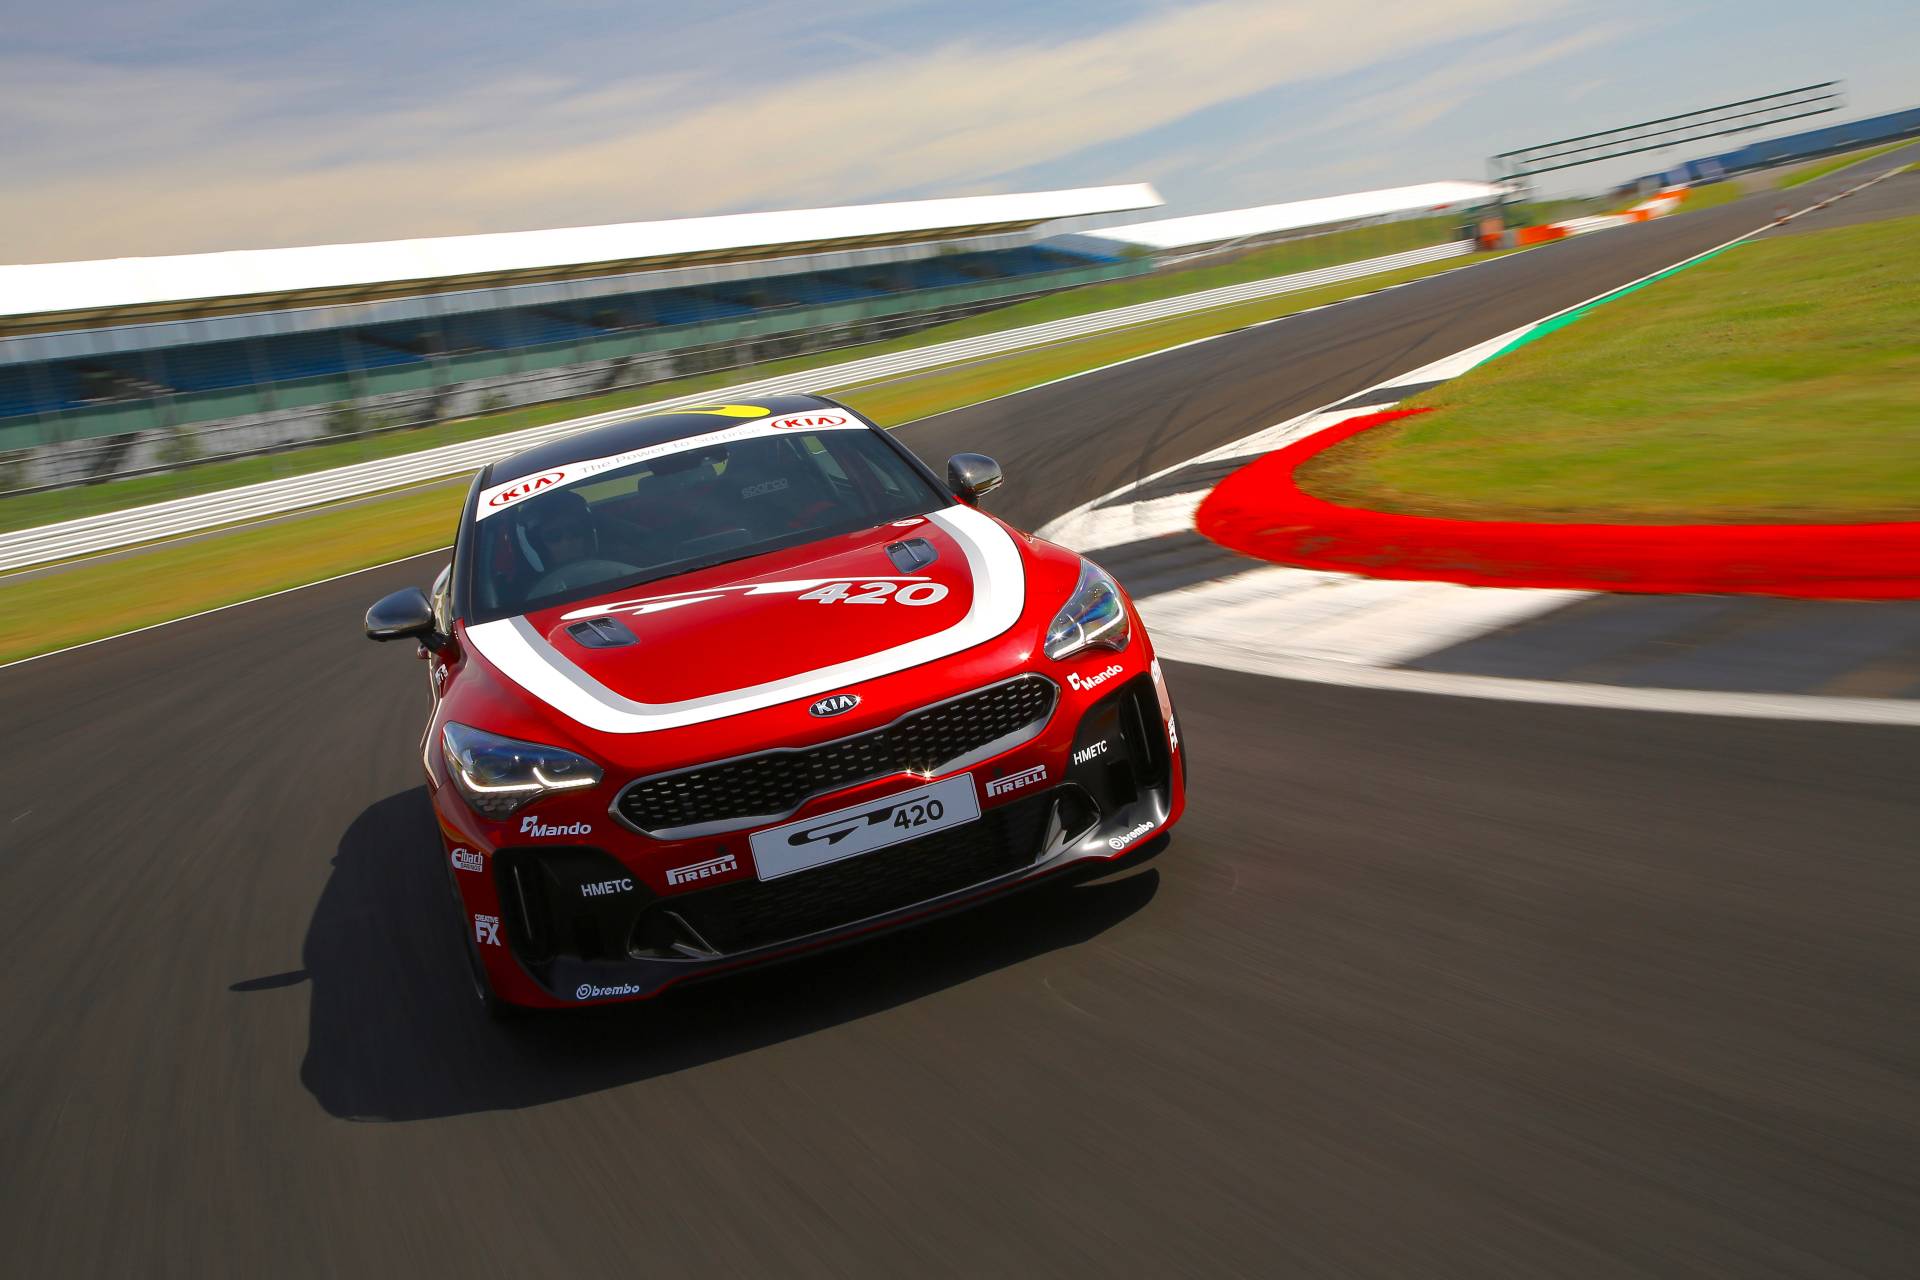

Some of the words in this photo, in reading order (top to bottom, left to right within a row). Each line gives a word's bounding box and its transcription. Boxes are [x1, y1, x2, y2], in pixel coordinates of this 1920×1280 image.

[783, 414, 836, 427] KIA
[582, 462, 612, 473] The
[615, 445, 665, 463] Power
[673, 440, 690, 448] to
[503, 478, 552, 501] KIA
[797, 581, 949, 606] 420
[1081, 663, 1123, 691] Mando
[815, 695, 857, 715] KIA
[1073, 740, 1107, 766] HMETC
[985, 764, 1047, 798] PIRELLI
[893, 800, 944, 830] 420
[531, 822, 592, 838] Mando
[1120, 820, 1155, 847] brembo
[451, 848, 483, 867] Eibach
[666, 854, 738, 885] PIRELLI
[581, 878, 634, 897] HMETC
[475, 920, 501, 947] FX
[592, 983, 640, 997] brembo
